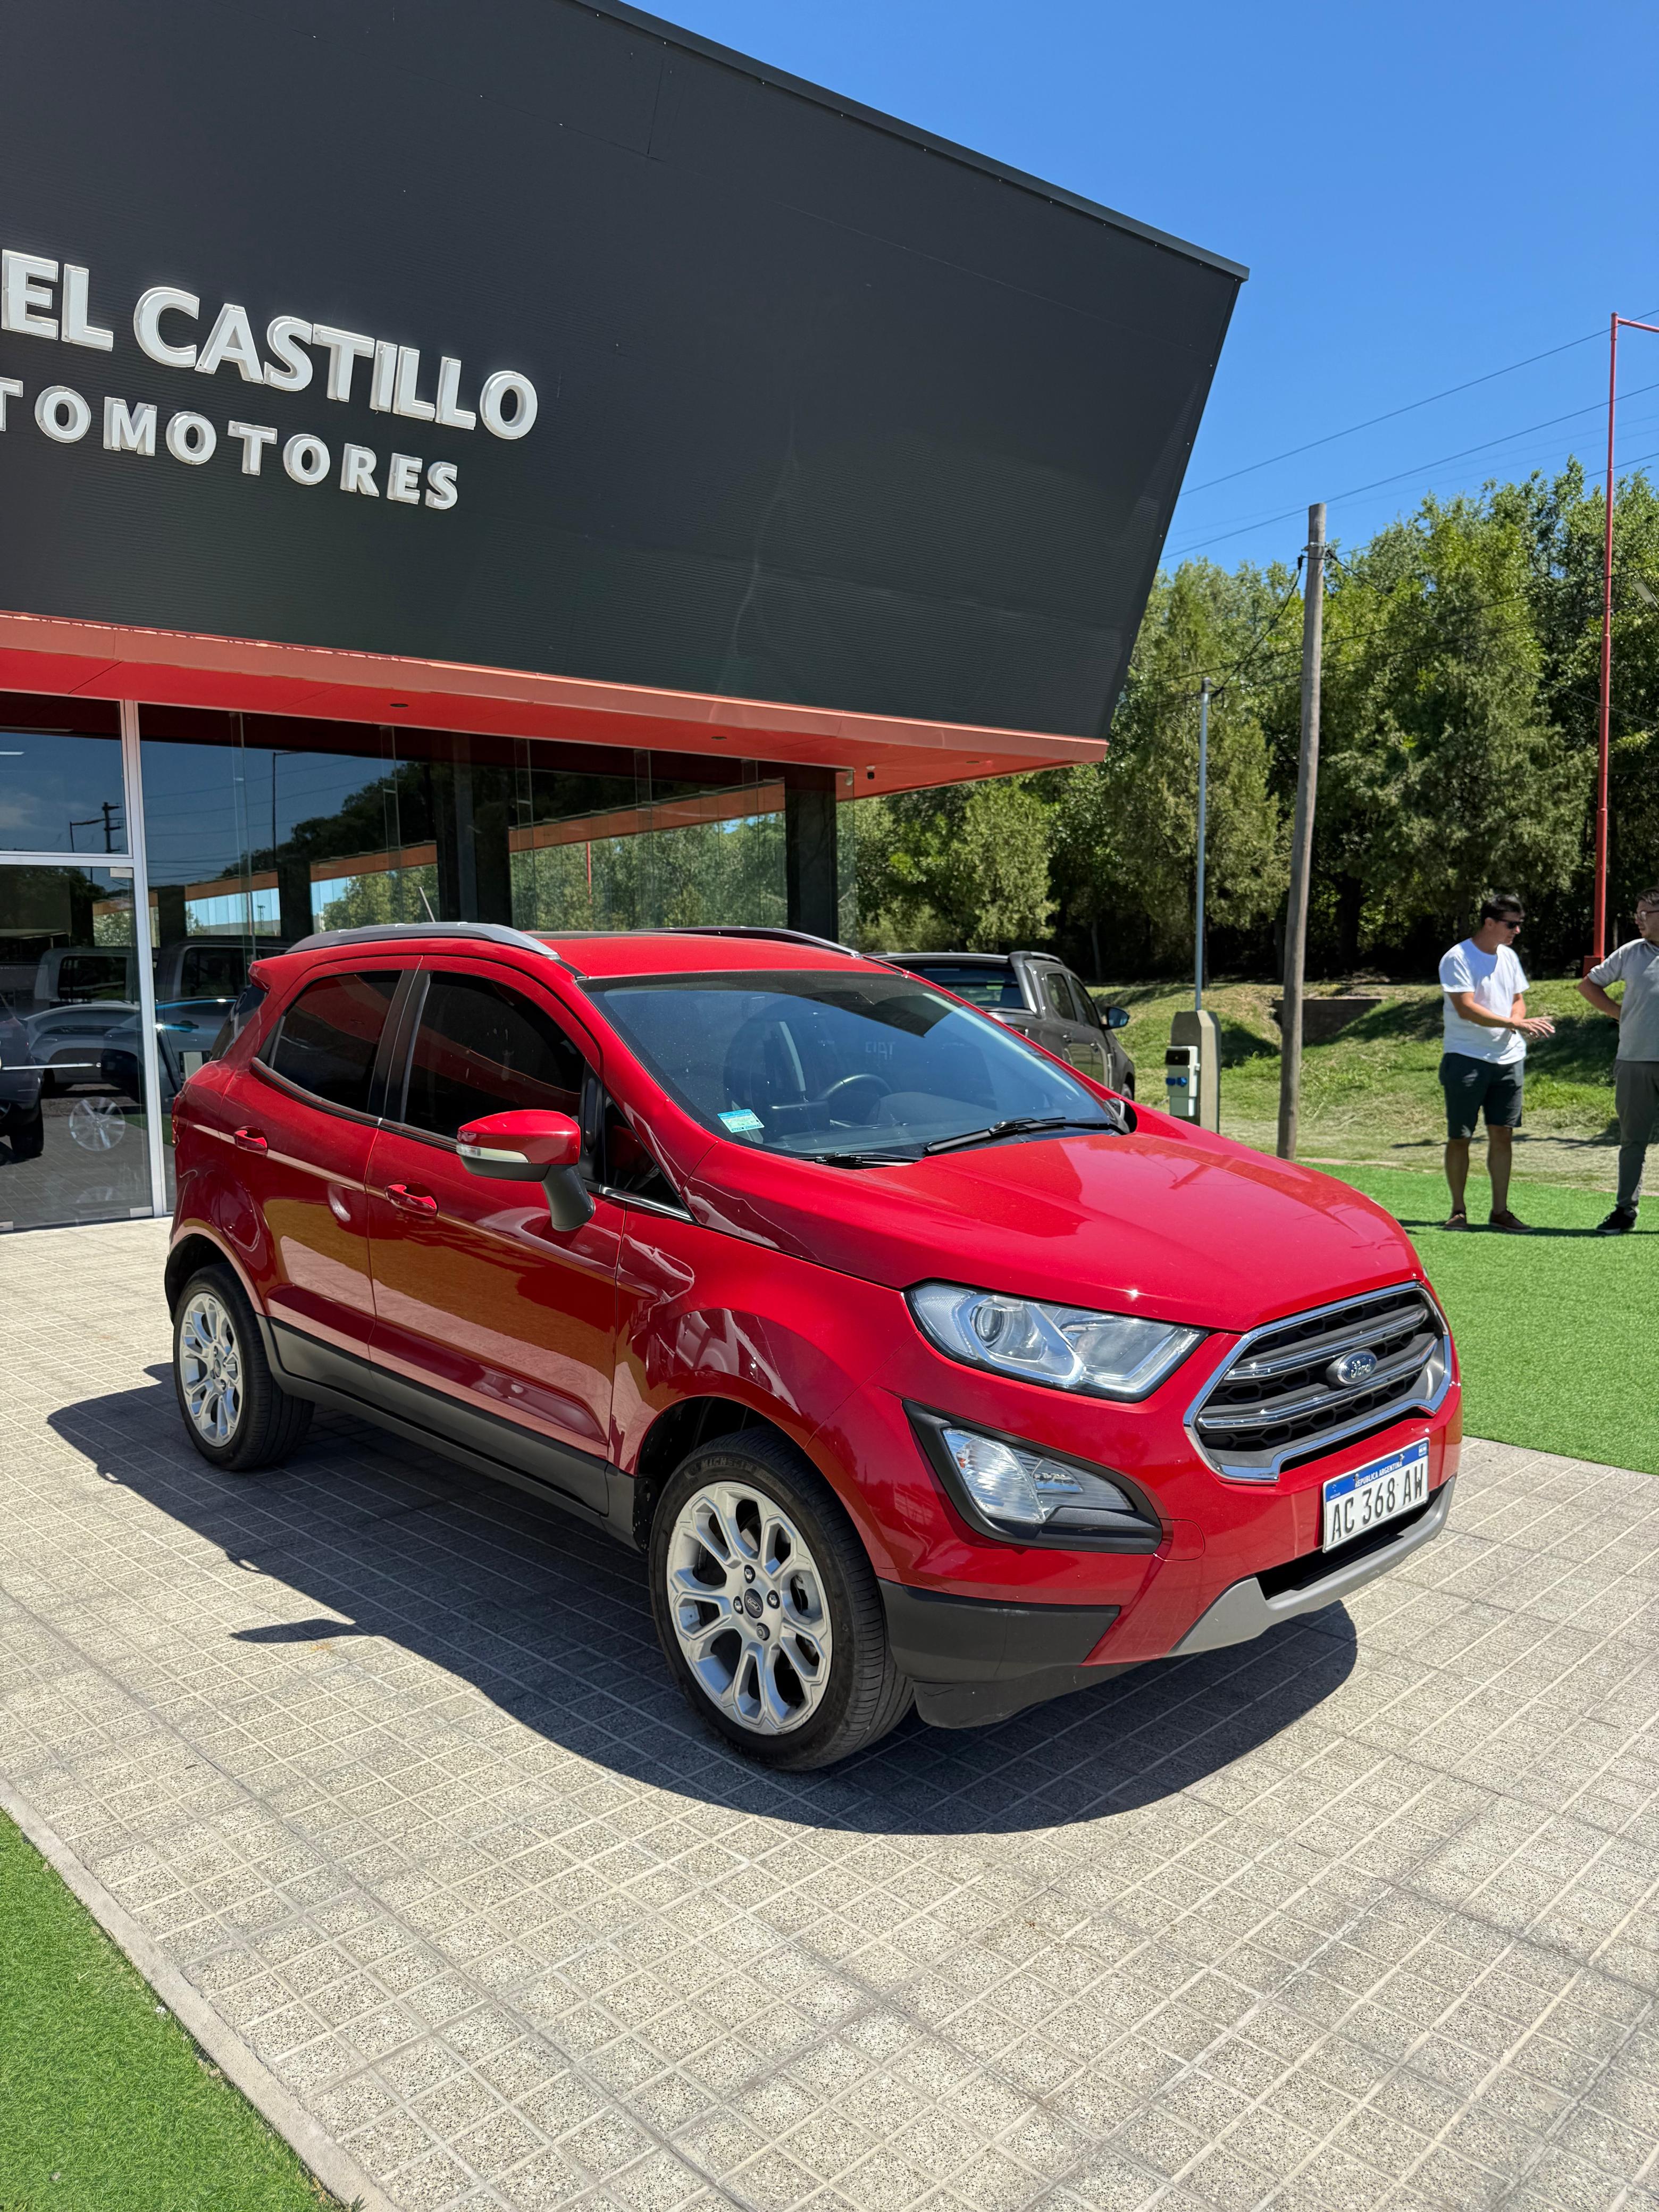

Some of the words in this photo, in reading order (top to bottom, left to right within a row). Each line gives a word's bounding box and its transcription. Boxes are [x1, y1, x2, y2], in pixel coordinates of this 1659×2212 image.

[1, 249, 113, 351] EL
[133, 286, 538, 439] CASTILLO
[701, 1457, 753, 1472] MICHELIN
[1331, 1497, 1354, 1541] AC
[1362, 1477, 1395, 1524] 368
[1402, 1463, 1423, 1506] AW
[747, 1598, 759, 1610] Ford
